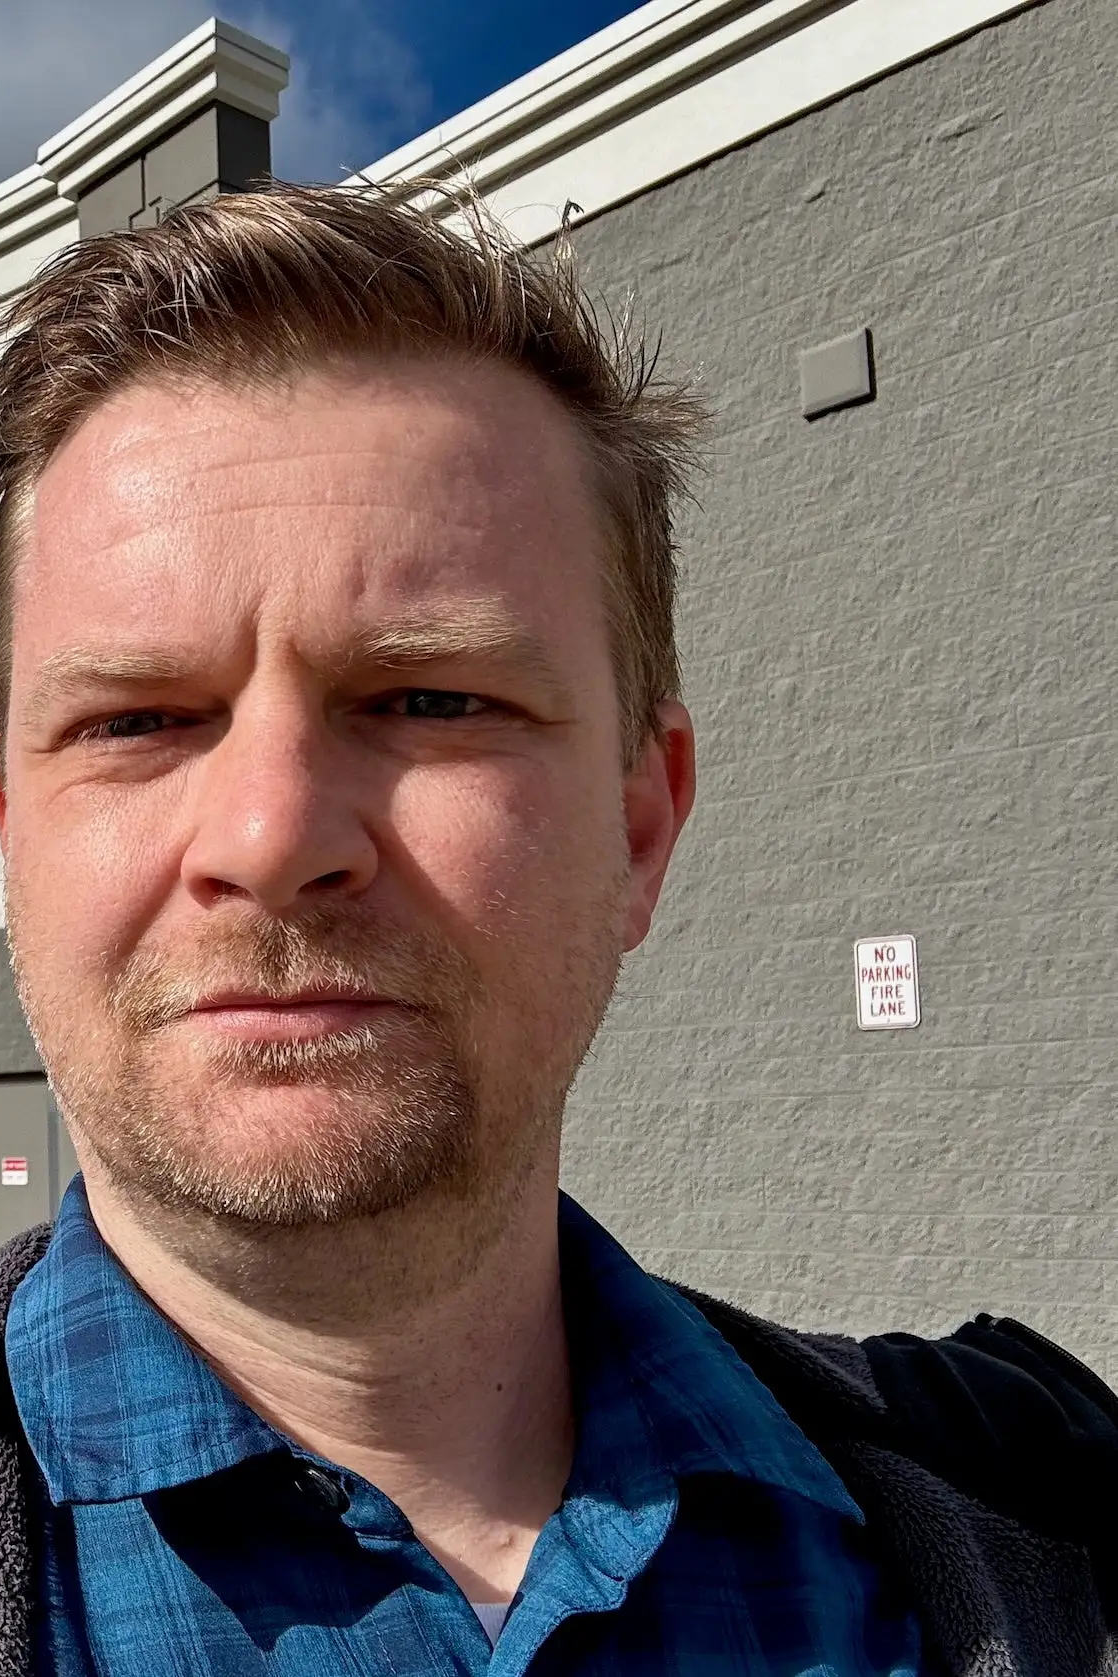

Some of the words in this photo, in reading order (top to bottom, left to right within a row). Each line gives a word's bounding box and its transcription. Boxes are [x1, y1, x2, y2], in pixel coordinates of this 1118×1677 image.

[874, 945, 896, 963] NO
[861, 964, 911, 982] PARKING
[871, 983, 904, 999] FIRE
[870, 1001, 906, 1017] LANE
